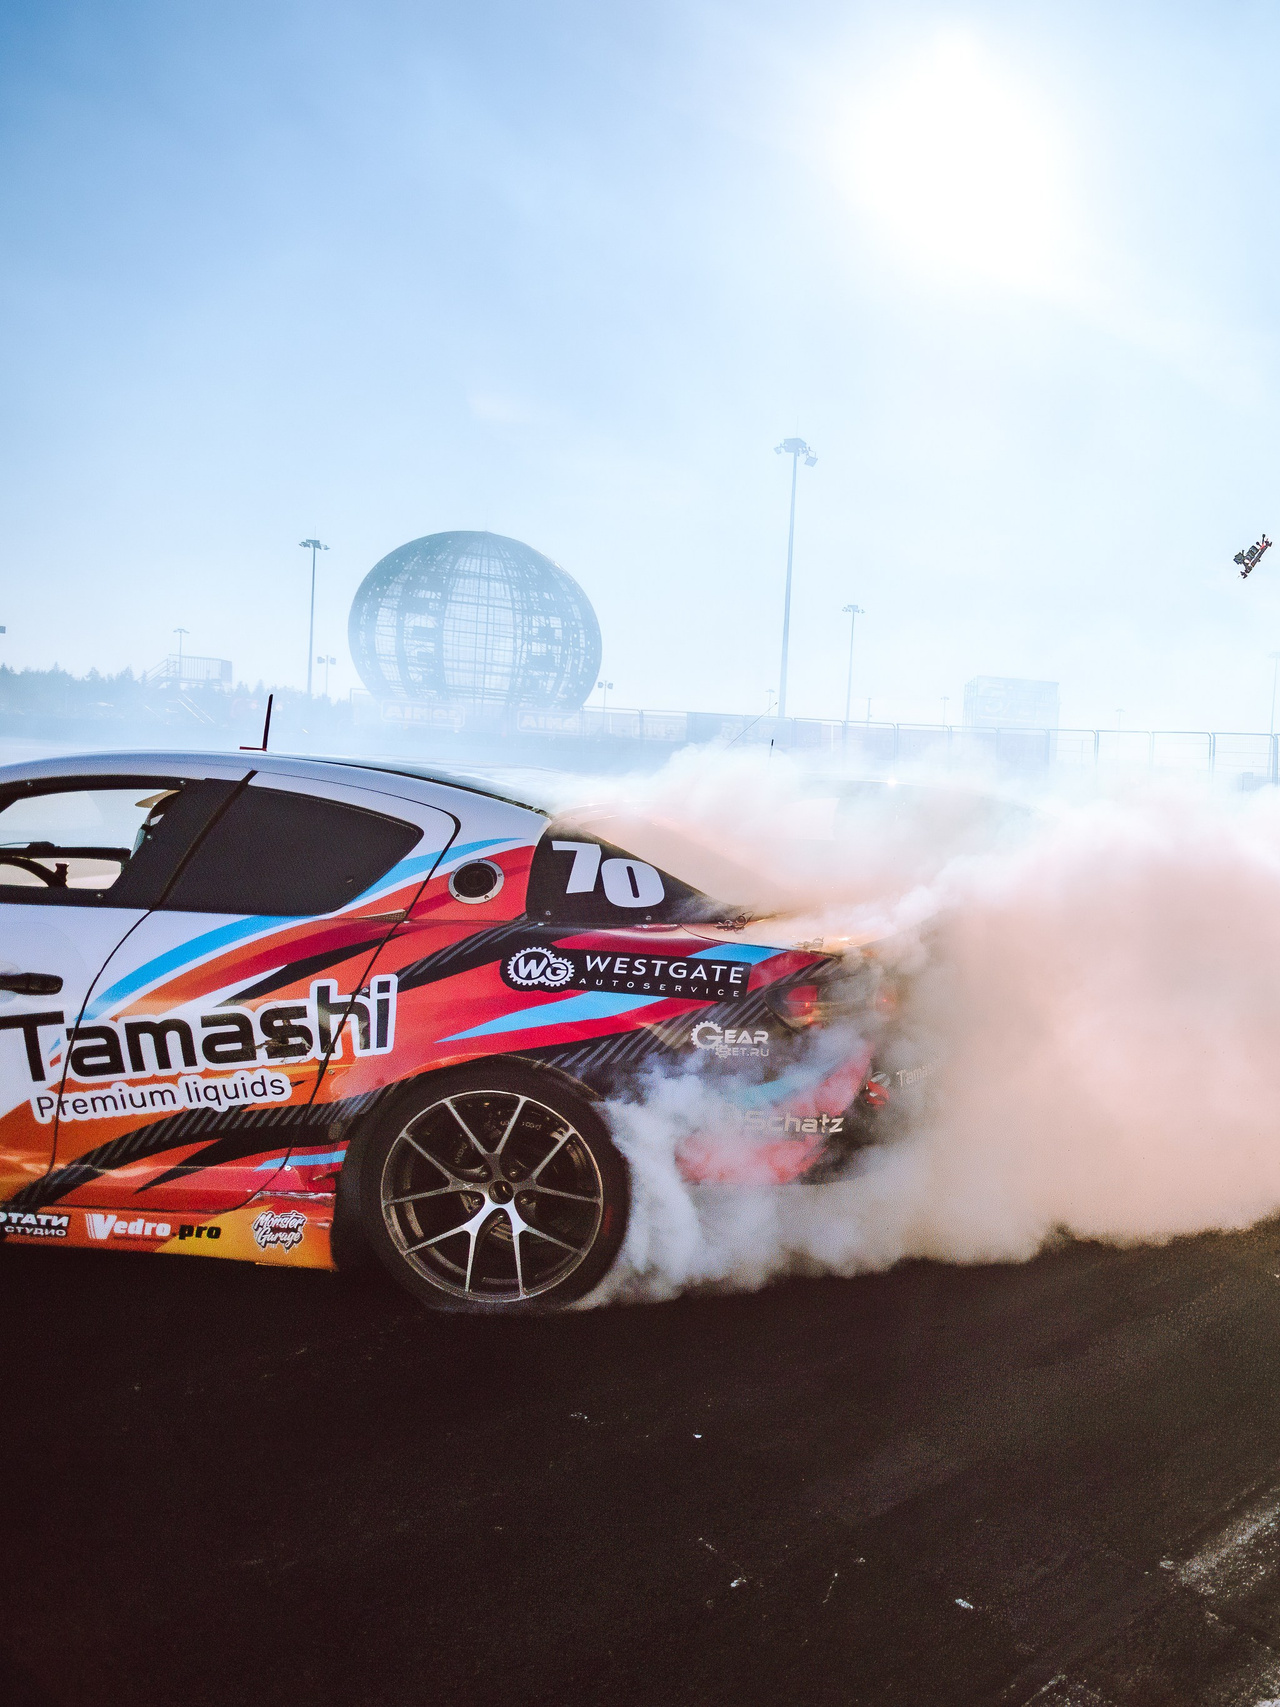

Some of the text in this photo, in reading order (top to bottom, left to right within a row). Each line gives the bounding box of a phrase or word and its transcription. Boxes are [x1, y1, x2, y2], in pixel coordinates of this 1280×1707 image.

[551, 840, 665, 908] 70
[585, 955, 744, 984] WESTGATE
[579, 978, 740, 998] AUTOSERVICE
[0, 980, 396, 1083] Tamashi
[691, 1021, 769, 1049] GEAR
[36, 1075, 286, 1119] Premium liquids
[744, 1110, 844, 1134] Schatz
[4, 1225, 67, 1237] СТУДИО
[253, 1212, 306, 1231] Monster
[258, 1227, 302, 1248] Garage
